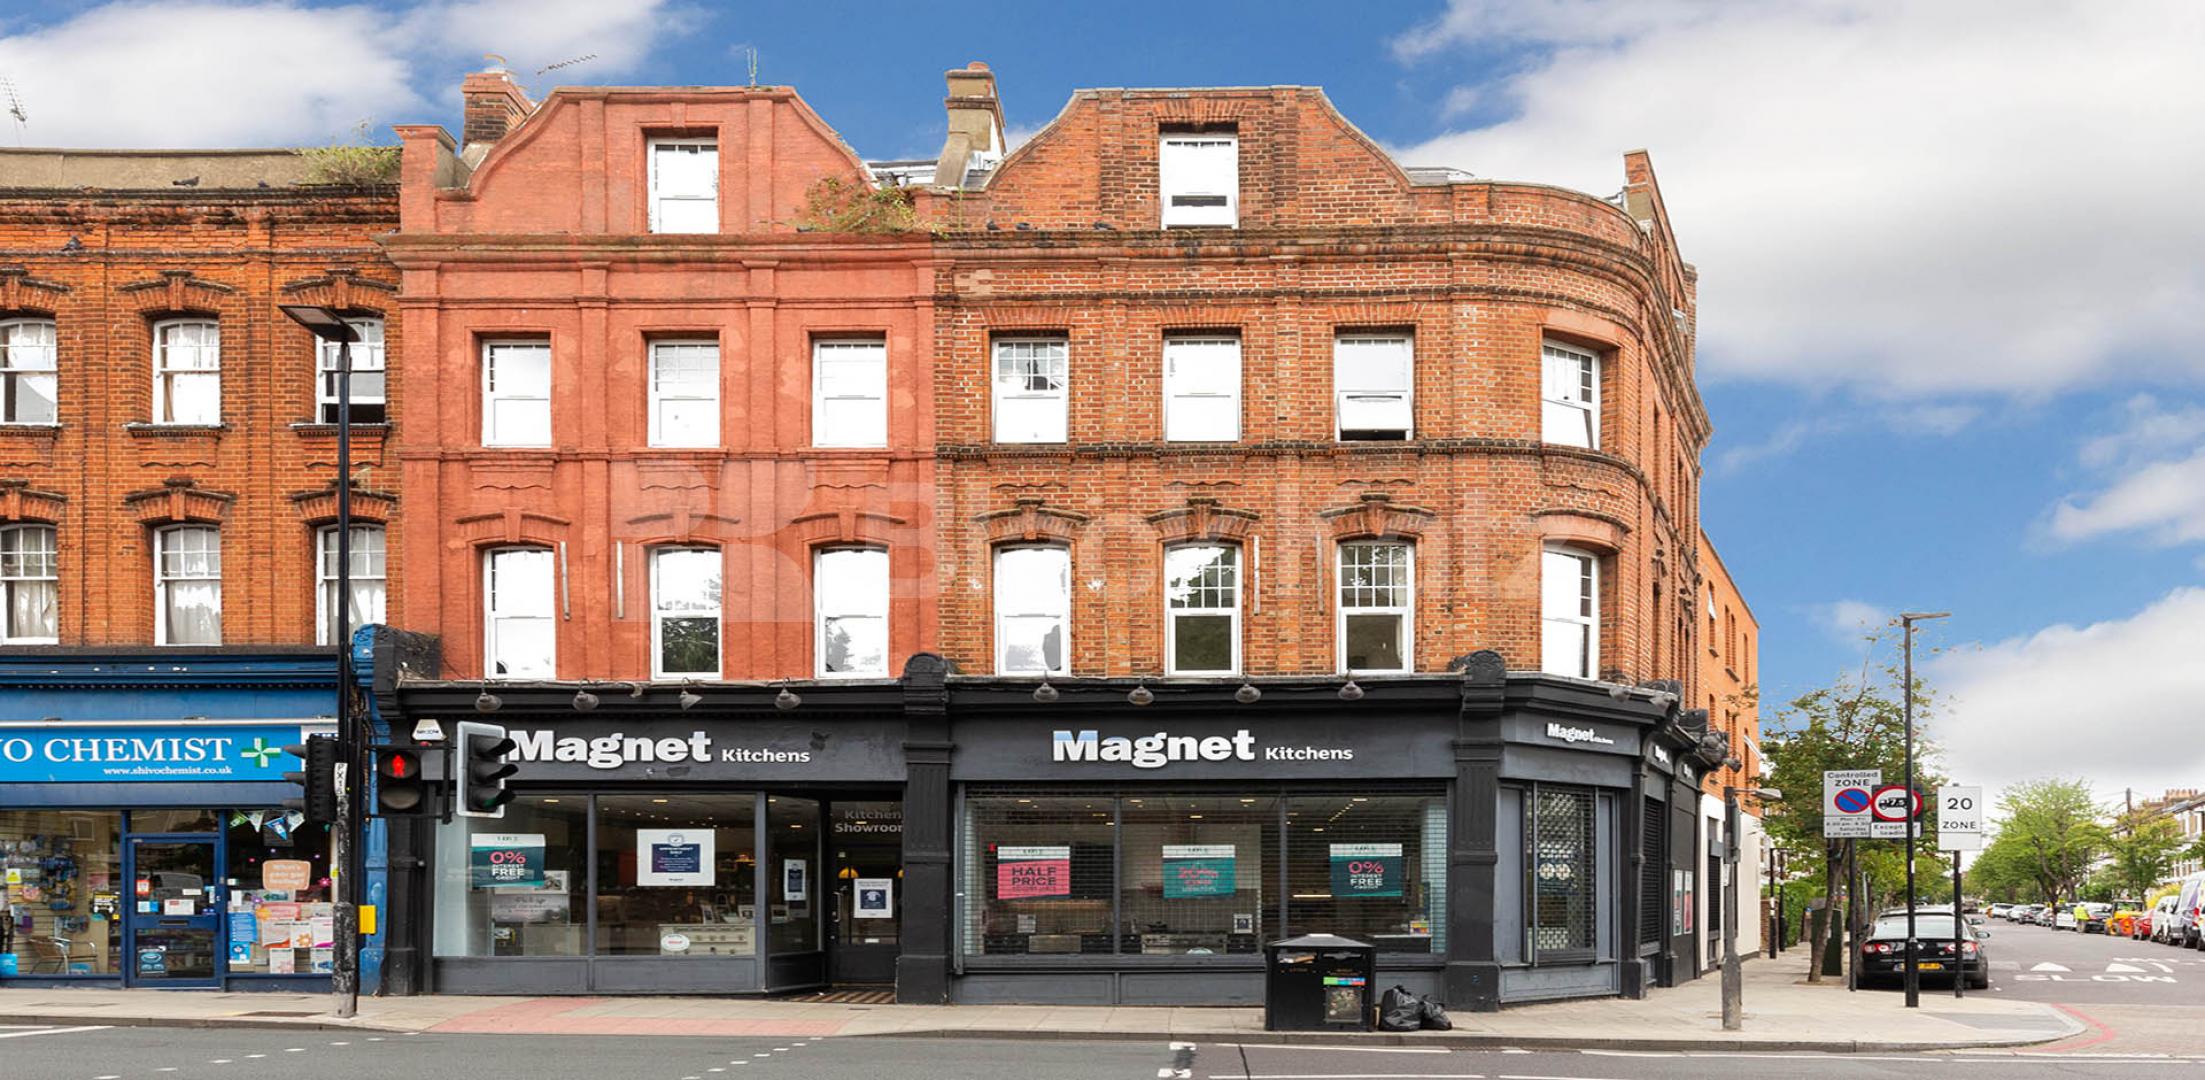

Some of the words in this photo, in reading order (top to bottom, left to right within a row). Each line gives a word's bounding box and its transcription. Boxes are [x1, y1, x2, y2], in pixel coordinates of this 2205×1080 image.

[1547, 723, 1595, 742] Magnet
[0, 737, 33, 762] O
[44, 738, 233, 762] CHEMIST
[509, 730, 712, 769] Magnet
[721, 747, 811, 764] Kitchens
[1052, 730, 1255, 768] Magnet
[1265, 744, 1354, 761] Kitchens
[103, 766, 233, 776] www.shivochemist.co.uk
[1835, 779, 1871, 787] ZONE
[1947, 798, 1973, 810] 20
[1942, 821, 1976, 829] ZONE
[490, 851, 527, 864] 0%
[491, 868, 525, 876] FREE
[1012, 867, 1057, 876] HALF
[1348, 861, 1385, 874] 0%
[1012, 877, 1057, 886] PRICE
[1350, 878, 1384, 886] FREE
[2013, 974, 2178, 983] SLOW
